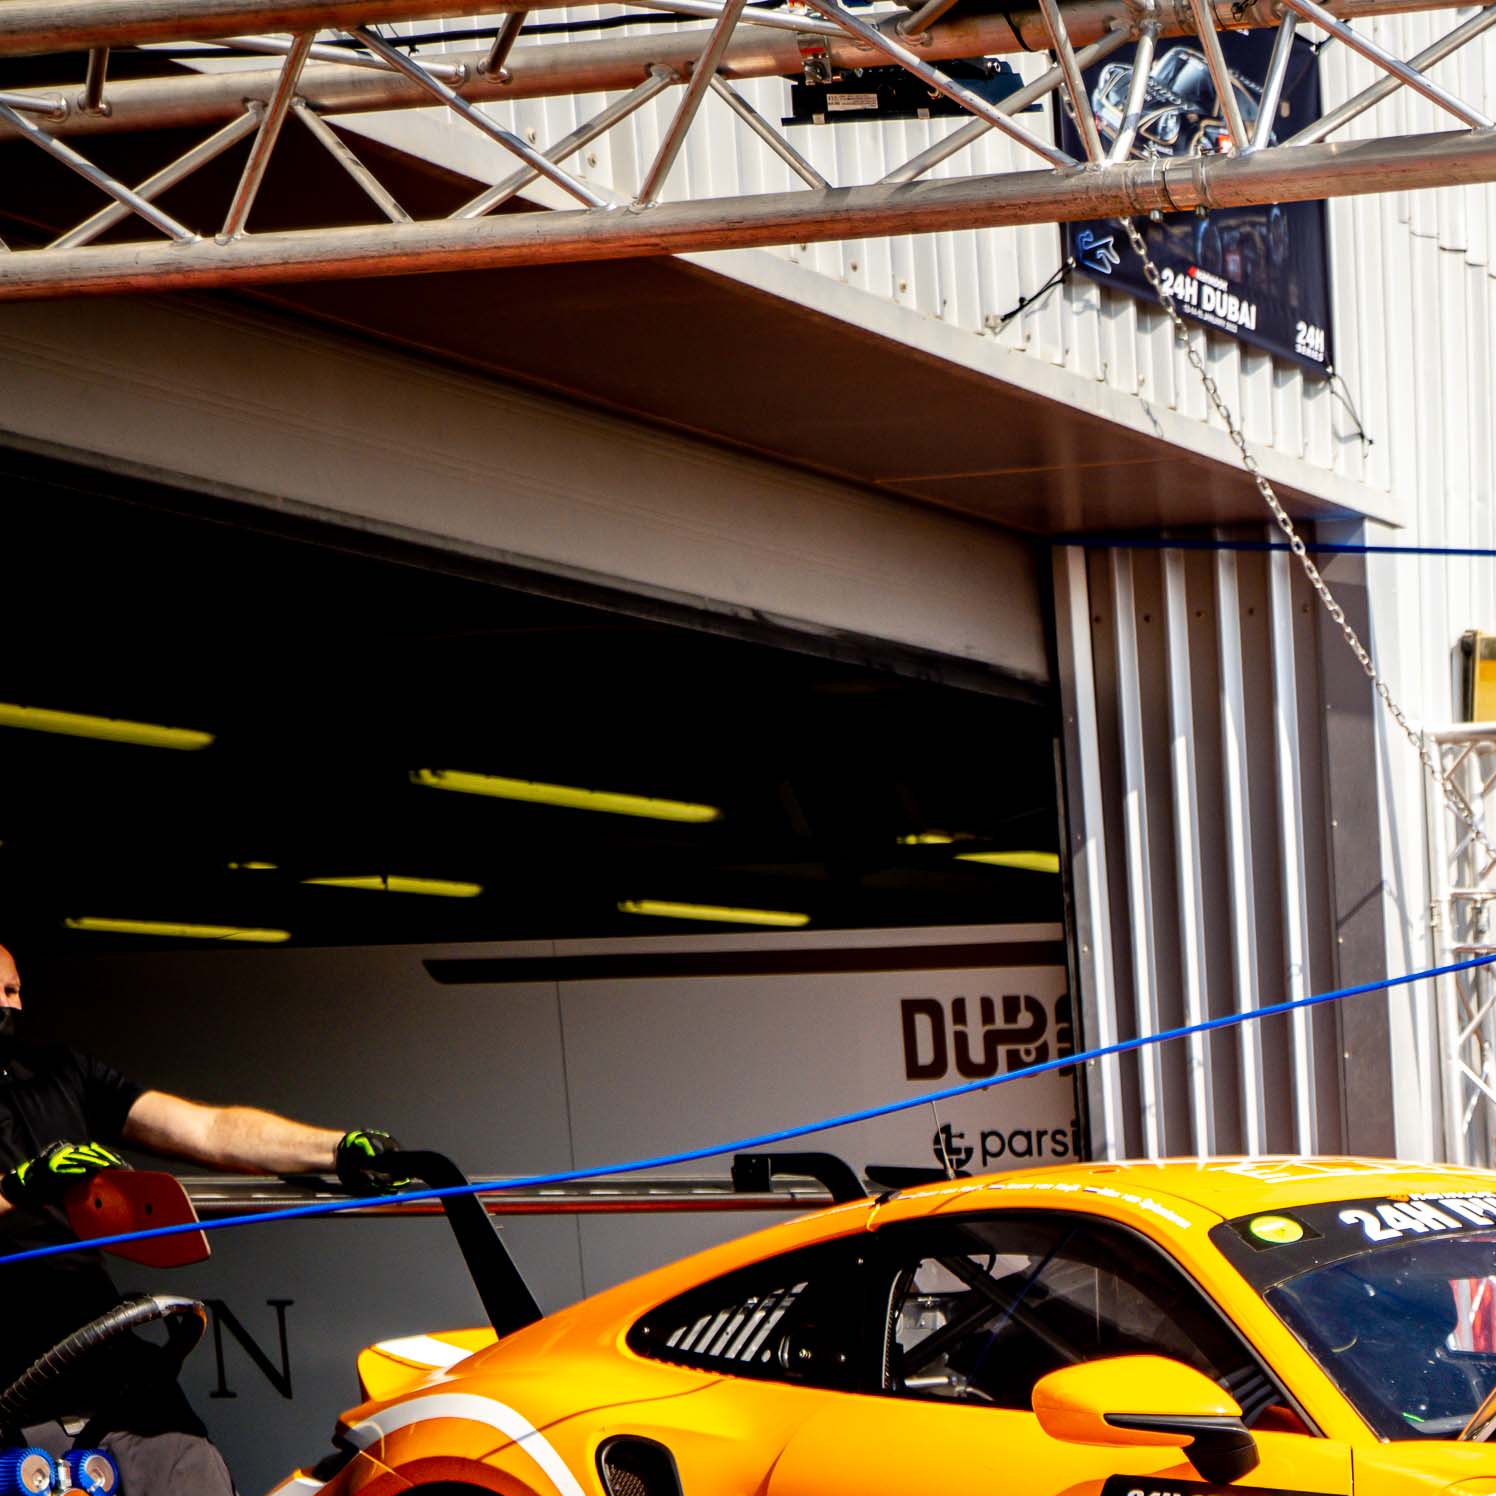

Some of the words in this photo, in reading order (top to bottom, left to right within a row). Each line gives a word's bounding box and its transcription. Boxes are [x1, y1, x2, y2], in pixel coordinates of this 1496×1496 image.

[1161, 267, 1198, 306] 24H
[1201, 285, 1257, 330] DUBAI
[1295, 320, 1325, 353] 24H
[1338, 1199, 1464, 1244] 24H
